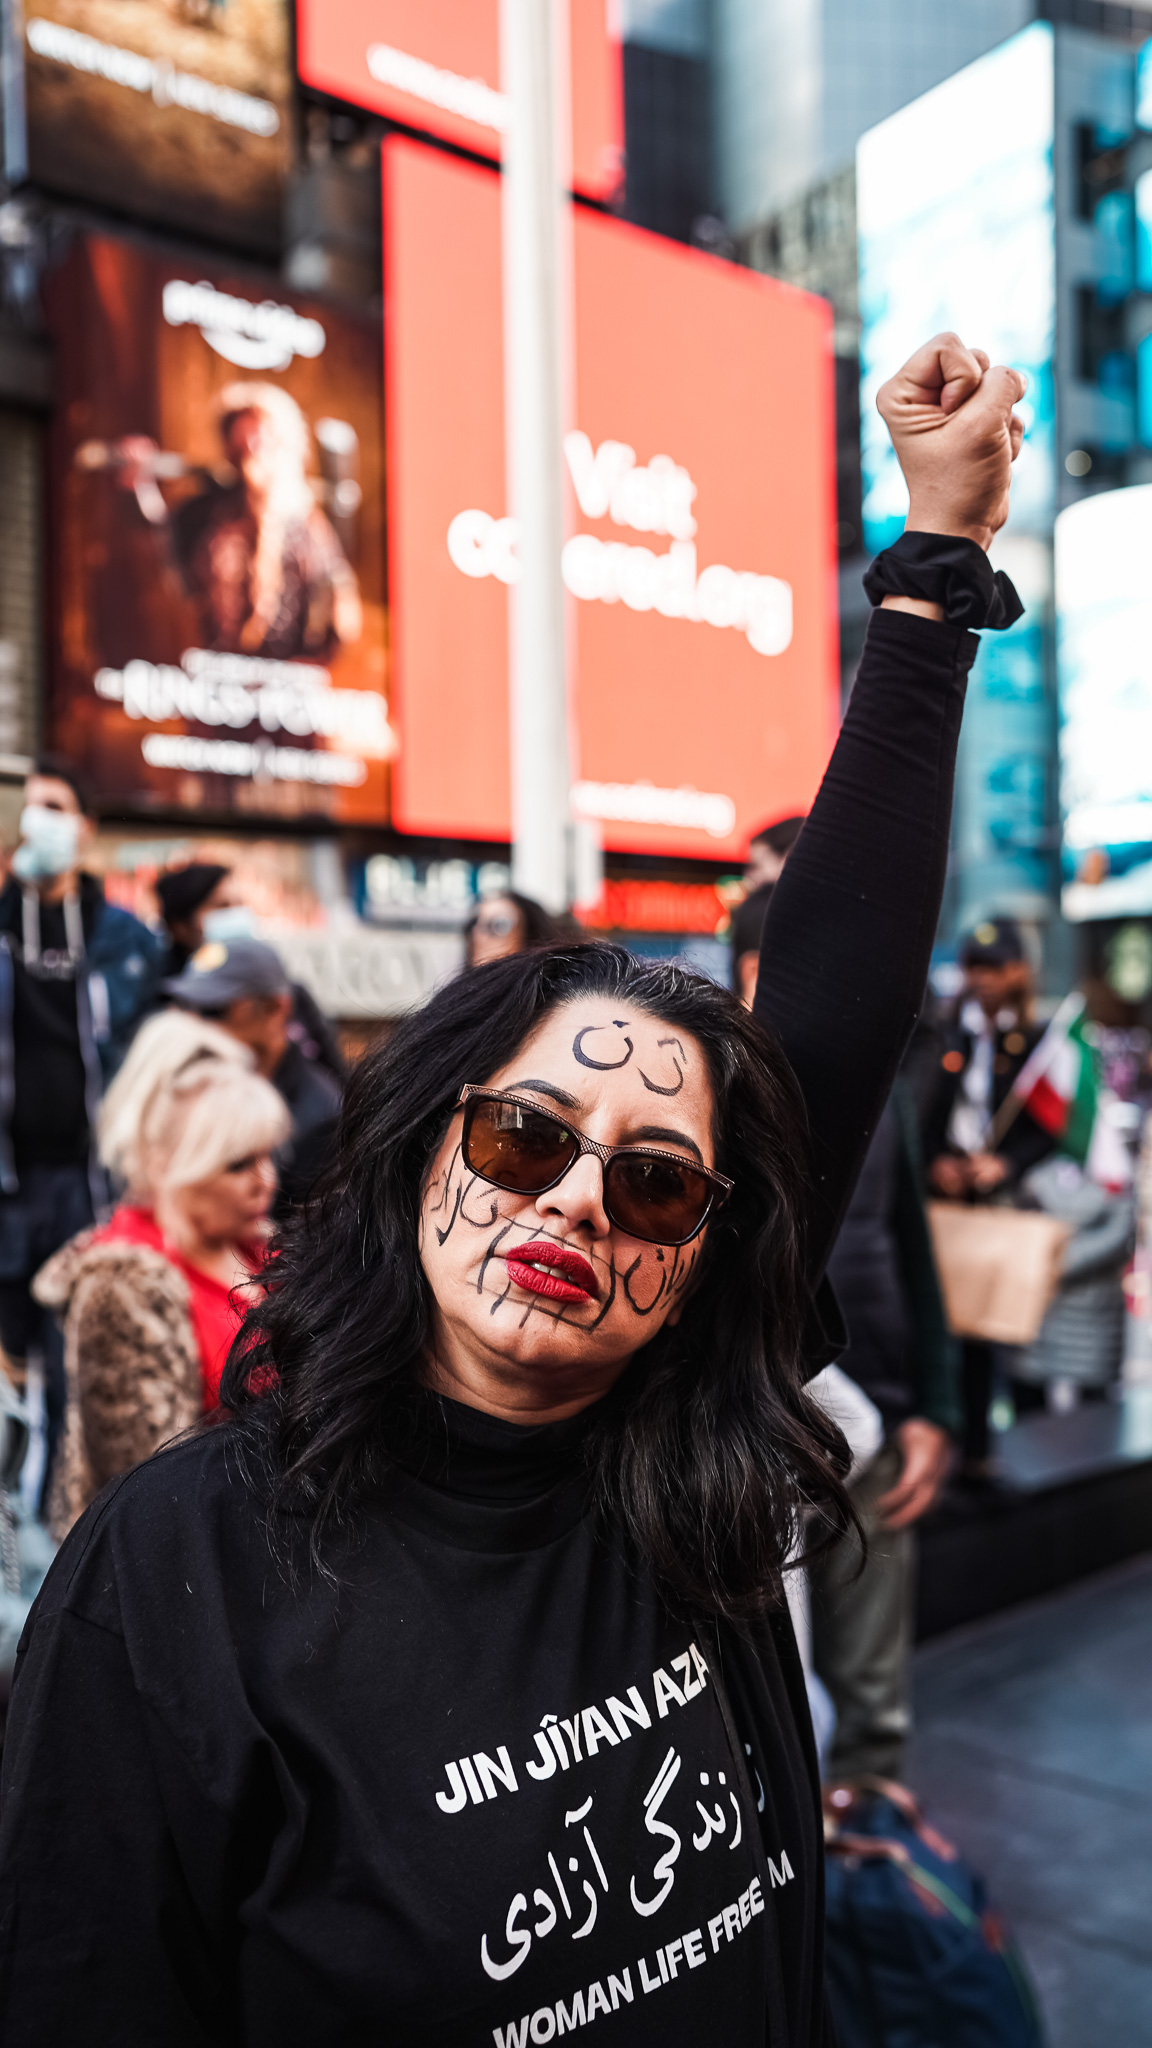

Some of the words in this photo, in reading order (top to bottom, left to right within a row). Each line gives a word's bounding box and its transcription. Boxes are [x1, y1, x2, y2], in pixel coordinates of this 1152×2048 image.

[435, 1745, 519, 1814] JIN
[526, 1685, 653, 1781] JÎYAN
[630, 1746, 743, 1917] زندگی
[481, 1796, 609, 1981] آزادی
[492, 1967, 635, 2048] WOMAN
[638, 1928, 707, 1994] LIFE
[708, 1849, 796, 1954] FREEM
